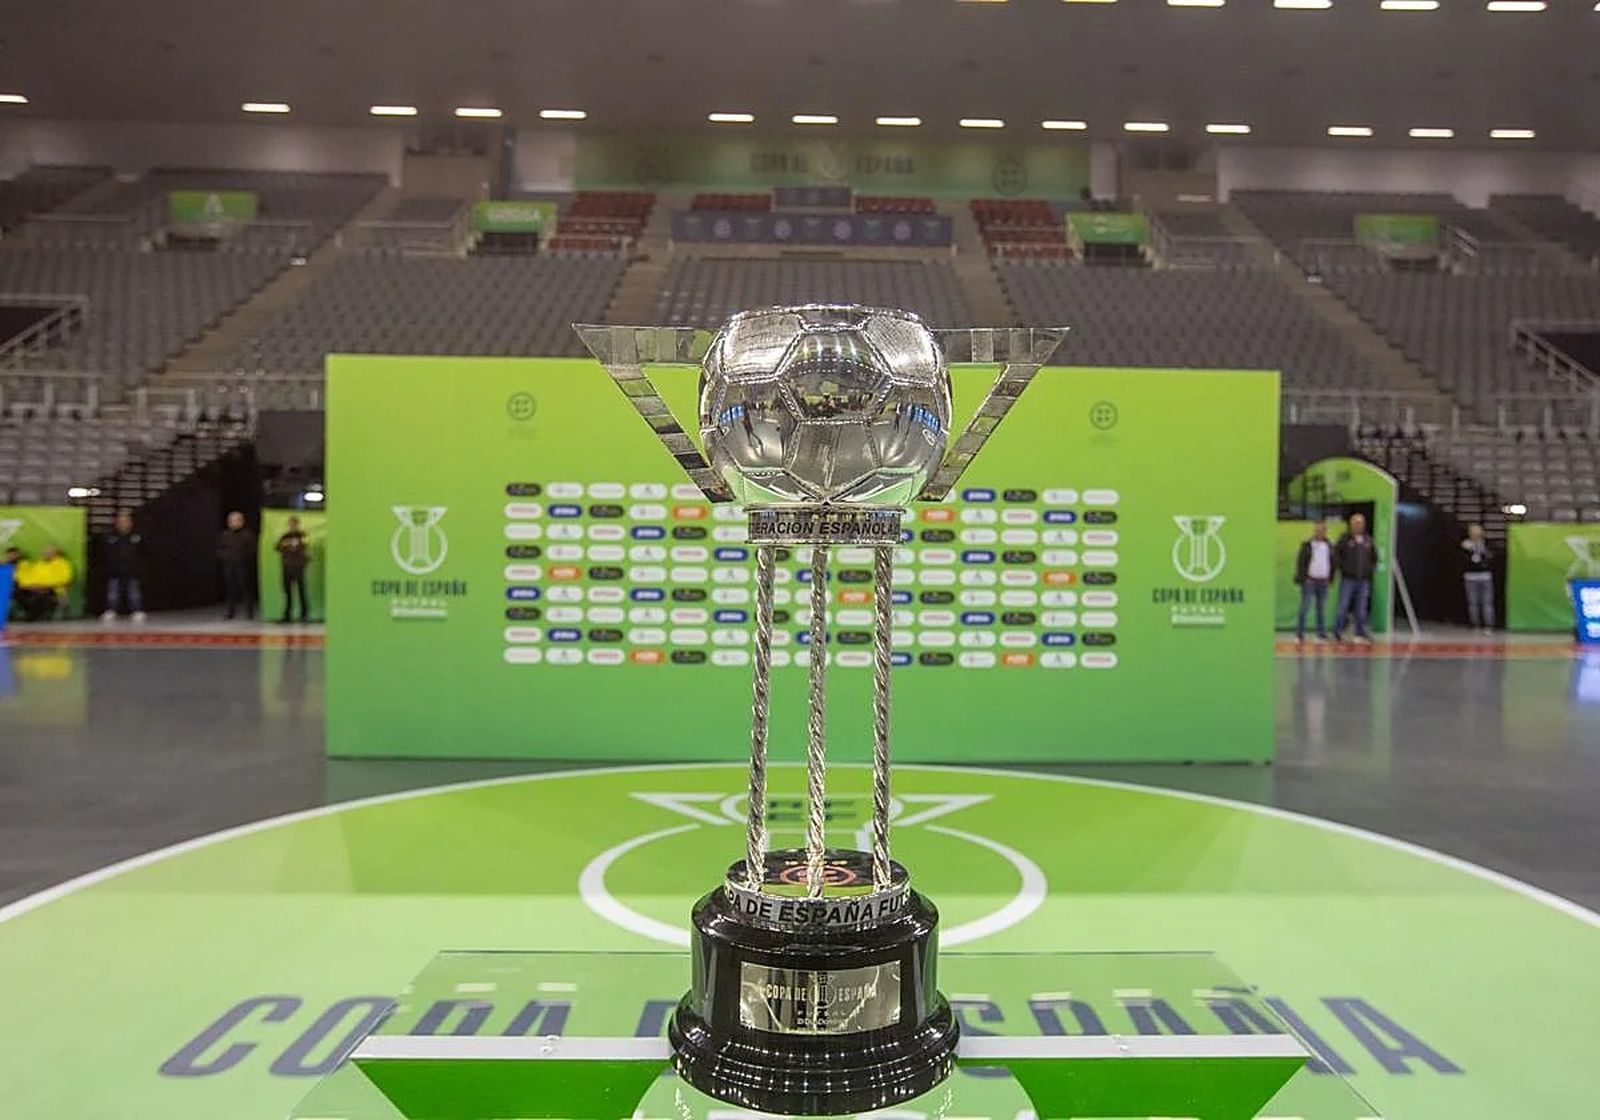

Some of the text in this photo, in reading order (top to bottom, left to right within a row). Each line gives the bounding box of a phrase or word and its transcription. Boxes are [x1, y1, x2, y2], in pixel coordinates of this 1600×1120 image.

[371, 578, 468, 597] COPA DE ESPAÑA
[1152, 585, 1245, 605] COPA DE ESPAÑA
[746, 901, 773, 919] DE
[778, 901, 873, 924] ESPAÑA
[766, 983, 793, 1001] COPA
